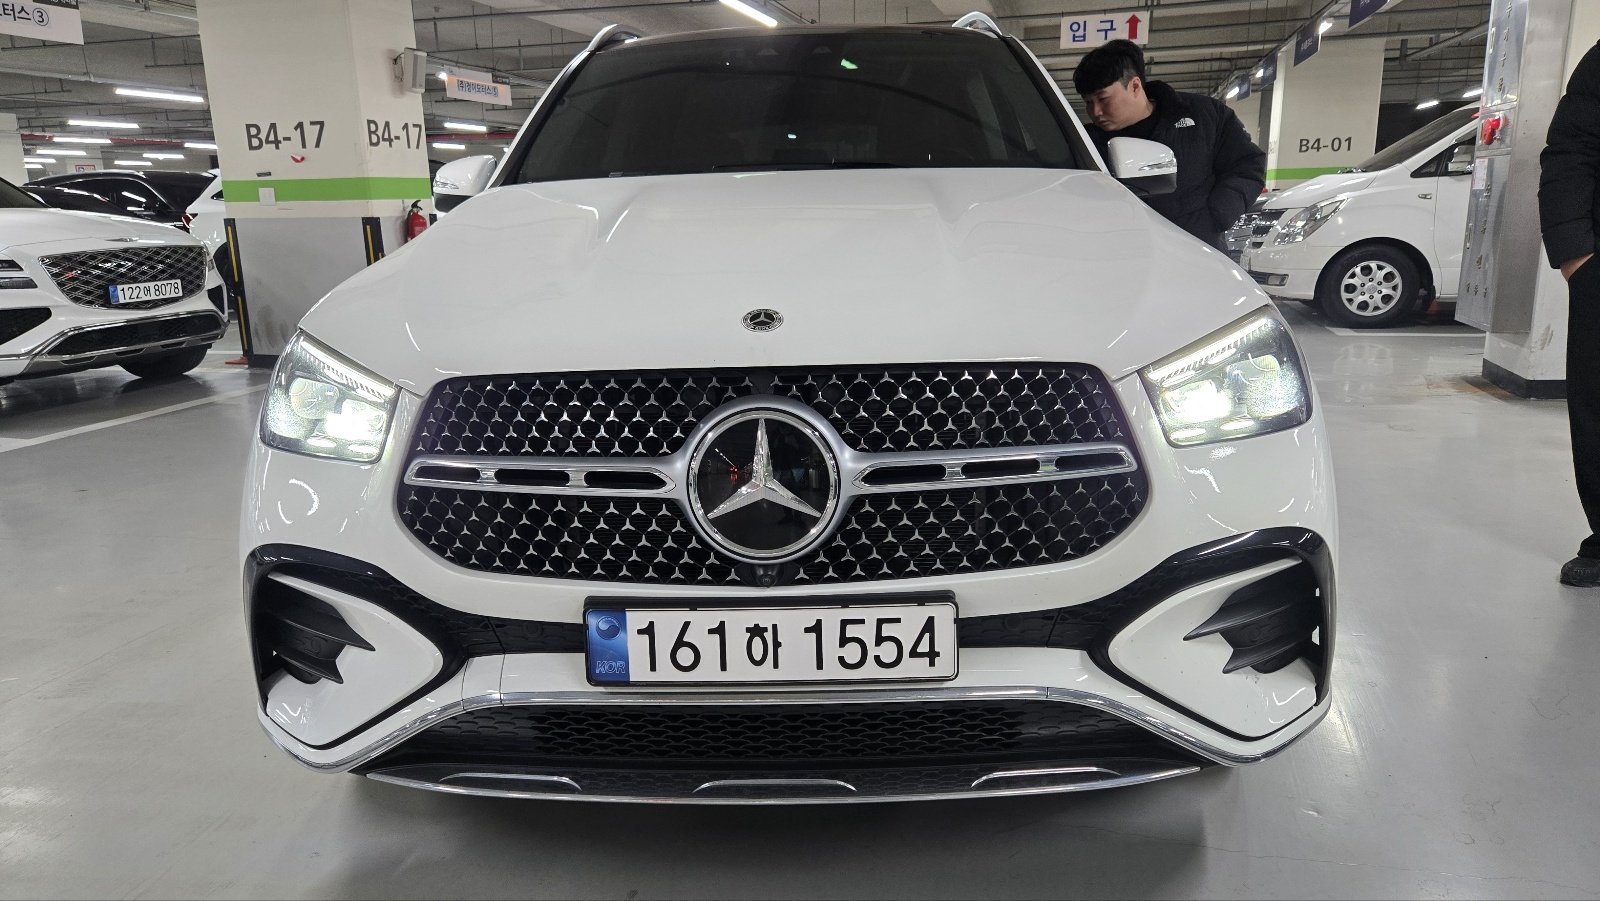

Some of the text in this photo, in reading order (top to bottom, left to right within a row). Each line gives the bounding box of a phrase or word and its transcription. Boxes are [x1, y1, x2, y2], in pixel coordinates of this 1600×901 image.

[245, 120, 325, 151] B4-17
[366, 119, 423, 150] B4-17
[1298, 136, 1353, 153] B4-01
[153, 281, 180, 297] 8078
[804, 616, 941, 670] 1554
[595, 660, 626, 674] KOR
